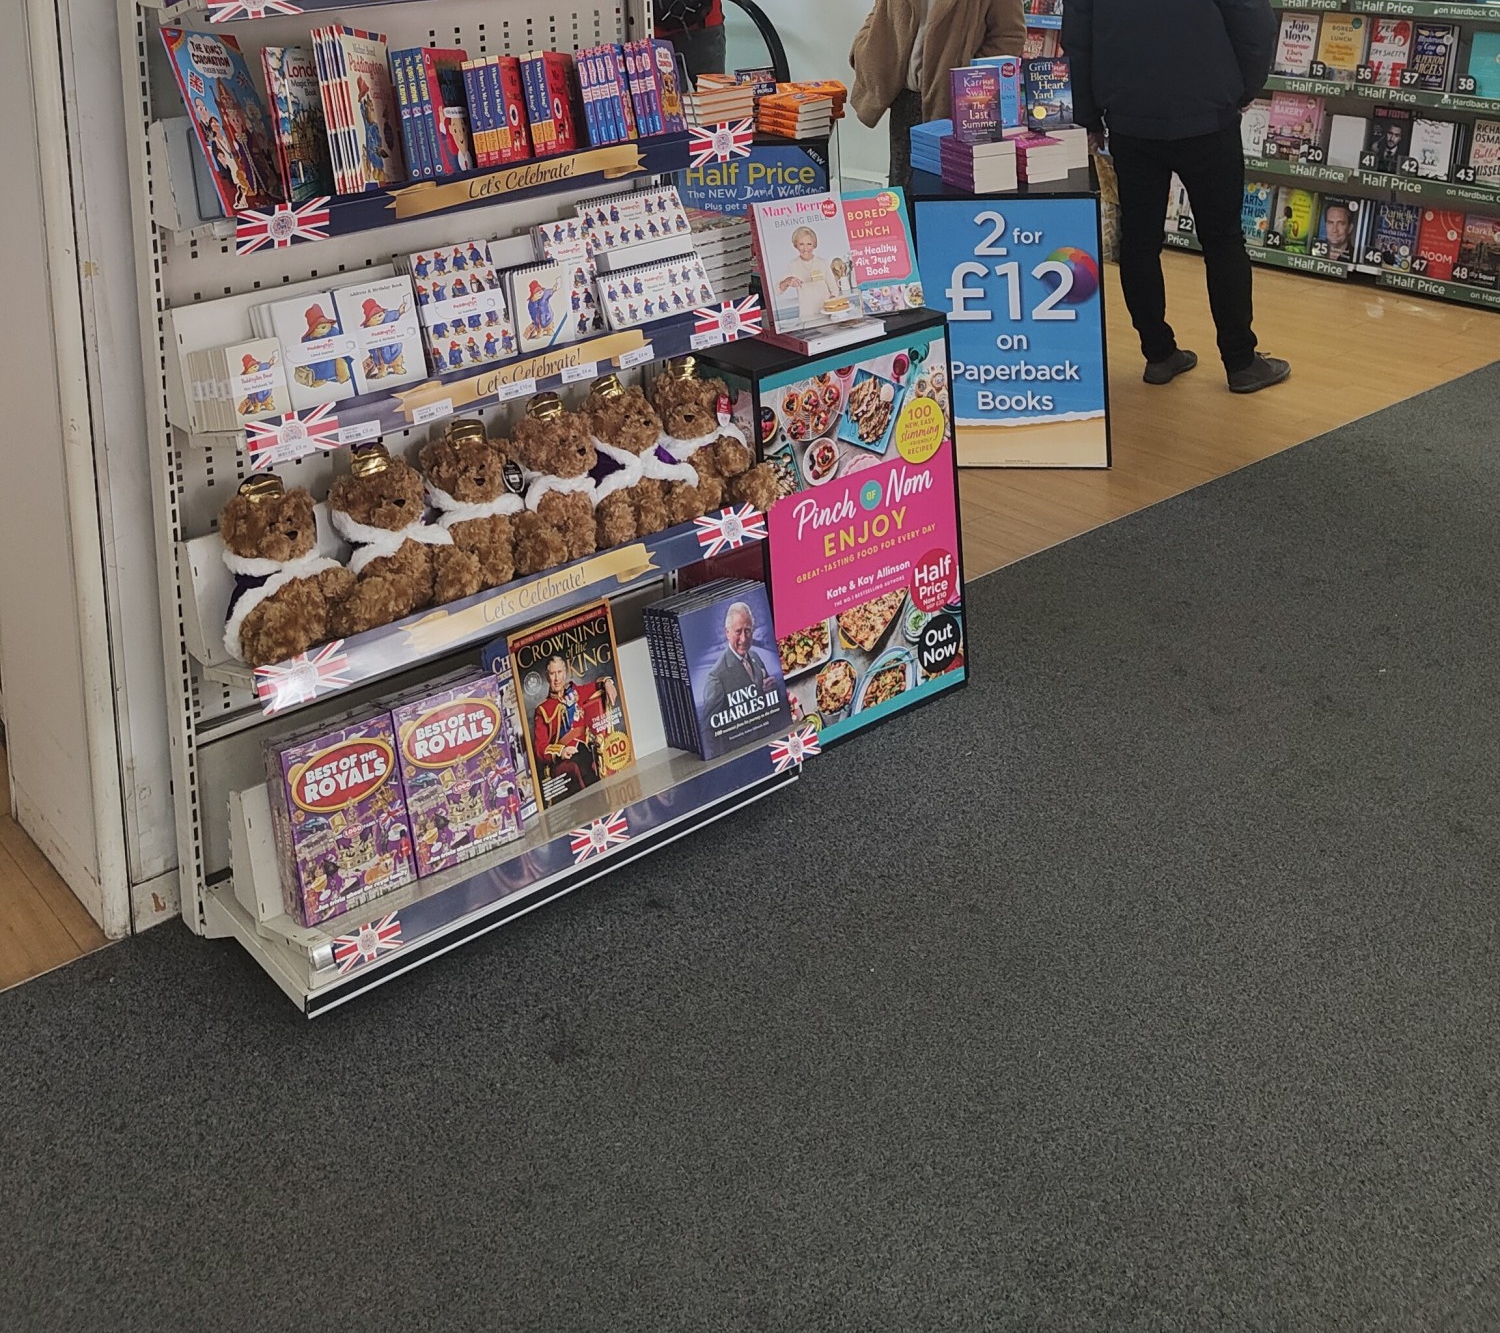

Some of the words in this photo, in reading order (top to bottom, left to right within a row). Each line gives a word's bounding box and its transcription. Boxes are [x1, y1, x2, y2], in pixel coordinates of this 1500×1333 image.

[1289, 20, 1310, 32] Jojo
[1283, 29, 1312, 43] Moyes
[190, 41, 203, 52] THE
[192, 53, 231, 67] CORONATION
[1358, 68, 1372, 79] 36
[1038, 81, 1064, 90] Heart
[1458, 78, 1474, 90] 38
[1032, 90, 1054, 100] Yard
[972, 102, 985, 110] The
[1274, 106, 1305, 117] BAKERY
[969, 110, 988, 119] Last
[962, 120, 997, 129] Summer
[806, 148, 826, 166] NEW
[1362, 155, 1375, 166] 41
[1402, 160, 1418, 172] 42
[469, 174, 500, 199] Let's
[505, 157, 575, 190] Celebrate!
[686, 163, 738, 186] Half
[748, 162, 816, 184] Price
[1456, 169, 1474, 182] 43
[687, 190, 706, 199] The
[709, 189, 737, 198] NEW
[738, 187, 774, 200] David
[778, 185, 824, 197] Walliams
[762, 205, 793, 218] Mary
[847, 208, 887, 221] BORED
[774, 218, 805, 228] BAKING
[851, 226, 890, 239] LUNCH
[973, 210, 1008, 256] 2
[1013, 227, 1043, 245] for
[864, 244, 898, 256] Healthy
[1365, 251, 1382, 263] 46
[1421, 250, 1452, 264] NOOM
[856, 256, 870, 265] Air
[871, 254, 897, 266] Fryer
[866, 265, 890, 276] Book
[1453, 267, 1468, 279] 48
[945, 261, 1077, 322] £12
[1392, 274, 1415, 288] Half
[1418, 281, 1446, 295] Price
[996, 333, 1028, 350] on
[951, 360, 1080, 386] Paperback
[977, 391, 1054, 412] Books
[908, 405, 932, 420] 100
[900, 424, 940, 443] slimming
[907, 444, 933, 455] RECIPES
[792, 489, 857, 540] Pinch
[866, 490, 876, 500] OF
[885, 466, 933, 507] Nom
[823, 506, 907, 558] ENJOY
[796, 553, 856, 584] GREAT-TASTING
[857, 546, 879, 560] FOOD
[881, 539, 896, 551] FOR
[898, 530, 920, 544] EVERY
[921, 523, 936, 536] DAY
[914, 554, 952, 587] Half
[827, 586, 848, 600] Kate
[849, 582, 856, 592] &
[857, 574, 875, 590] Kay
[877, 559, 911, 580] Allinson
[919, 580, 949, 600] Price
[924, 623, 953, 647] Out
[517, 617, 607, 669] CROWNING
[566, 646, 574, 659] of
[575, 641, 588, 654] the
[922, 640, 957, 666] Now
[566, 643, 612, 679] KING
[606, 740, 627, 758] 100
[306, 762, 338, 784] BEST
[340, 756, 357, 772] OF
[360, 749, 378, 765] THE
[304, 757, 386, 804] ROYALS
